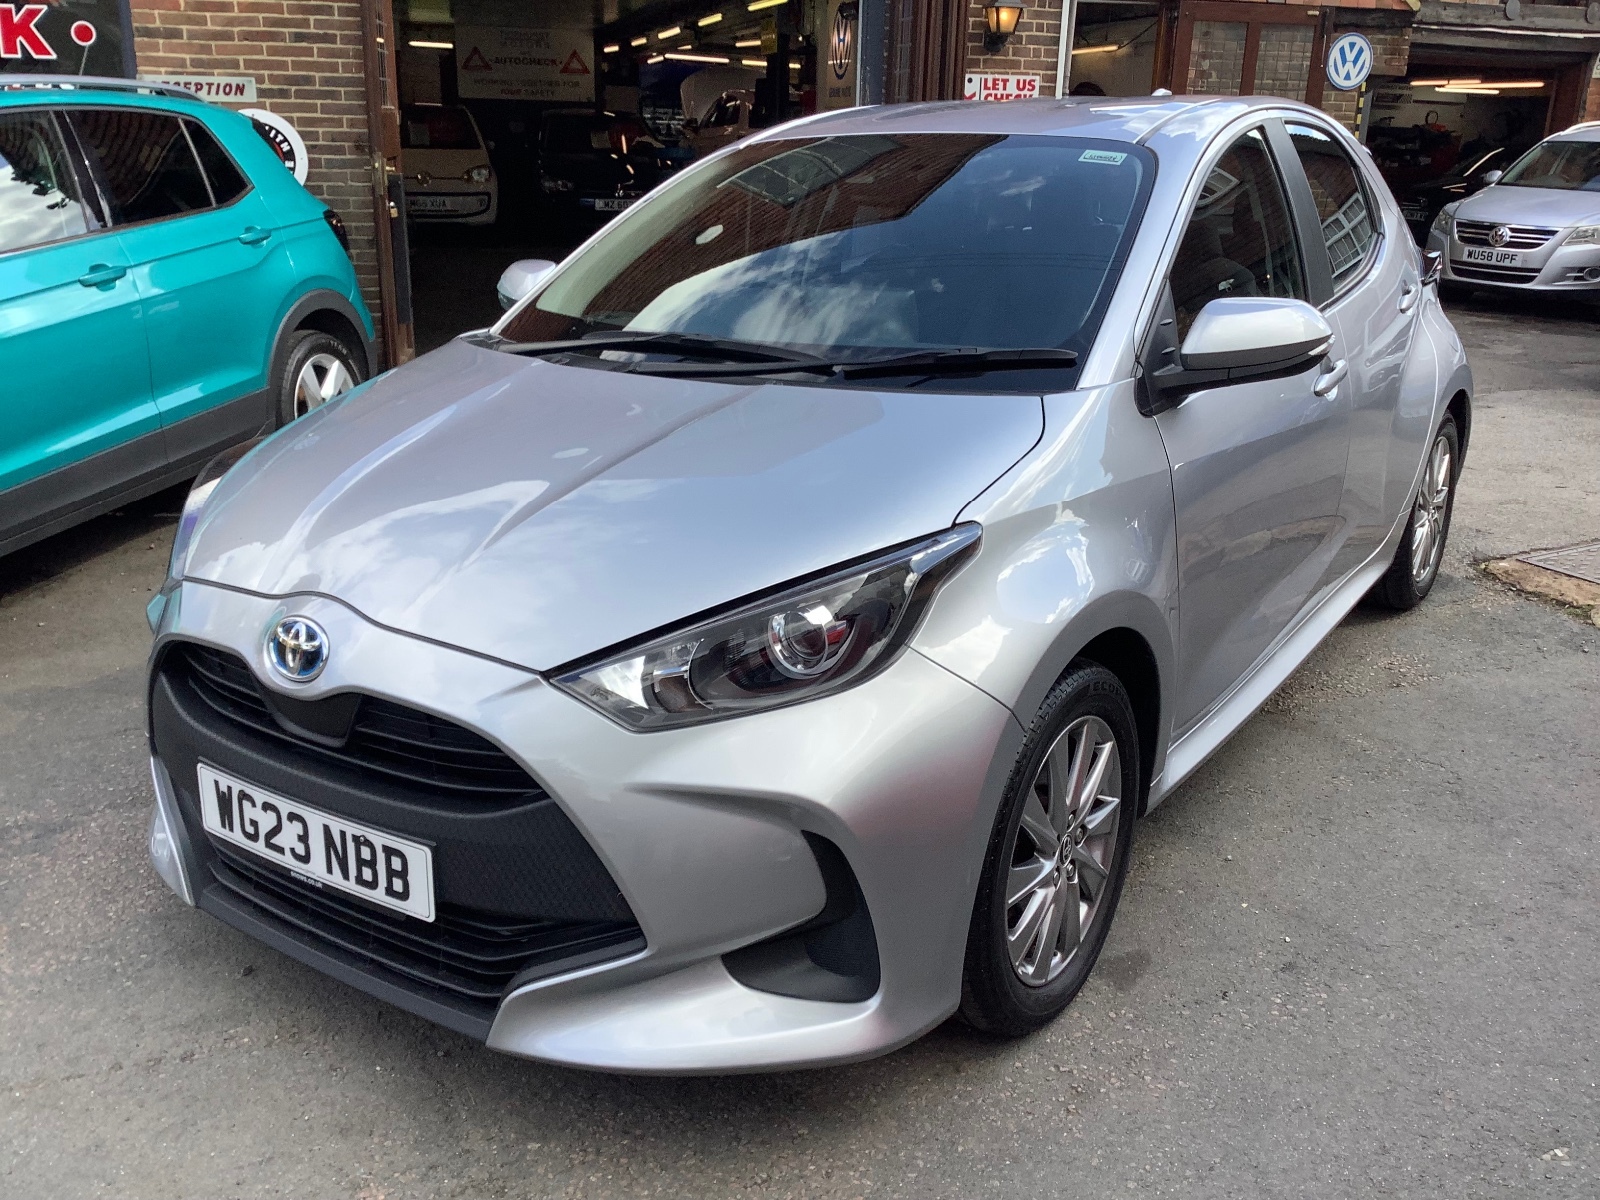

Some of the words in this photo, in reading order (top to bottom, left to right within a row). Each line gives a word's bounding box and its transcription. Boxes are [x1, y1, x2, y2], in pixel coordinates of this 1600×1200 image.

[494, 56, 558, 66] AUTOCHECK
[159, 81, 245, 97] EPTION
[983, 78, 1009, 91] LET
[1016, 79, 1036, 92] US
[1467, 249, 1493, 261] WU58
[1496, 252, 1518, 264] UPF
[214, 779, 311, 865] WG23
[322, 823, 410, 902] NBB
